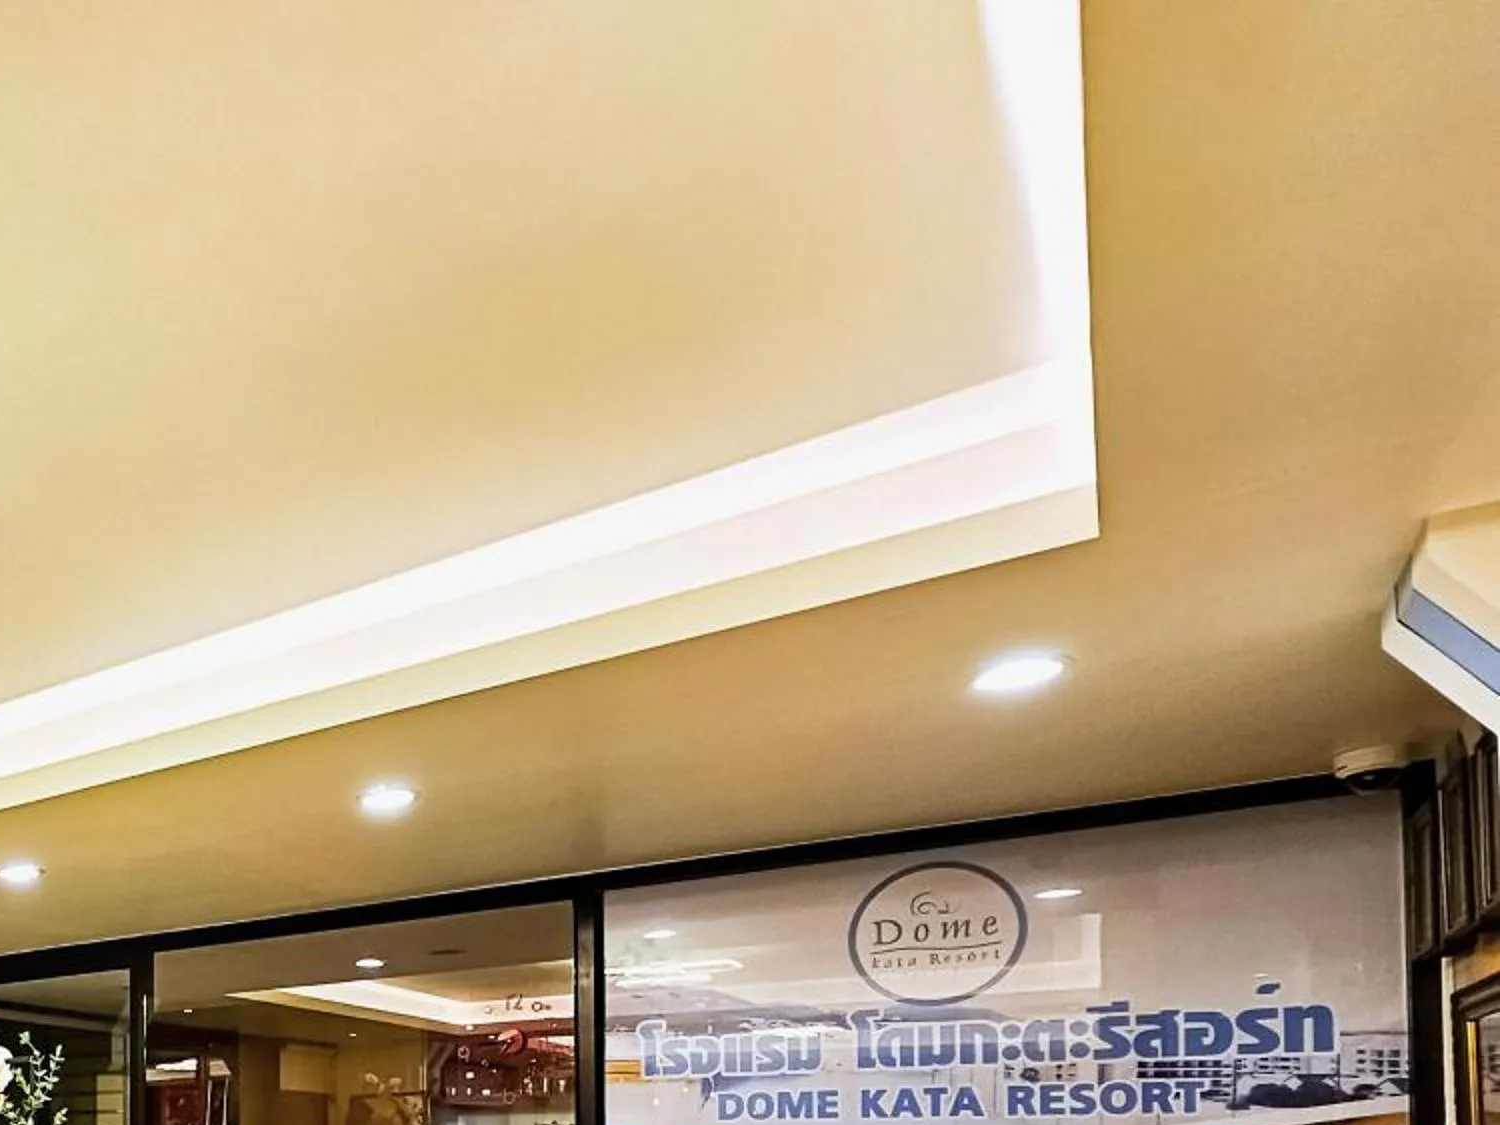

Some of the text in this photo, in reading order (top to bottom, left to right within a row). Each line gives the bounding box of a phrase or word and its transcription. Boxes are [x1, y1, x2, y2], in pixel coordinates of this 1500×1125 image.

[871, 915, 1000, 946] Dome
[929, 949, 1001, 966] Resort
[639, 982, 1336, 1077] โรงแรม โดมกะตะรีสอร์ท
[717, 1080, 1206, 1121] DOME KATA RESORT
